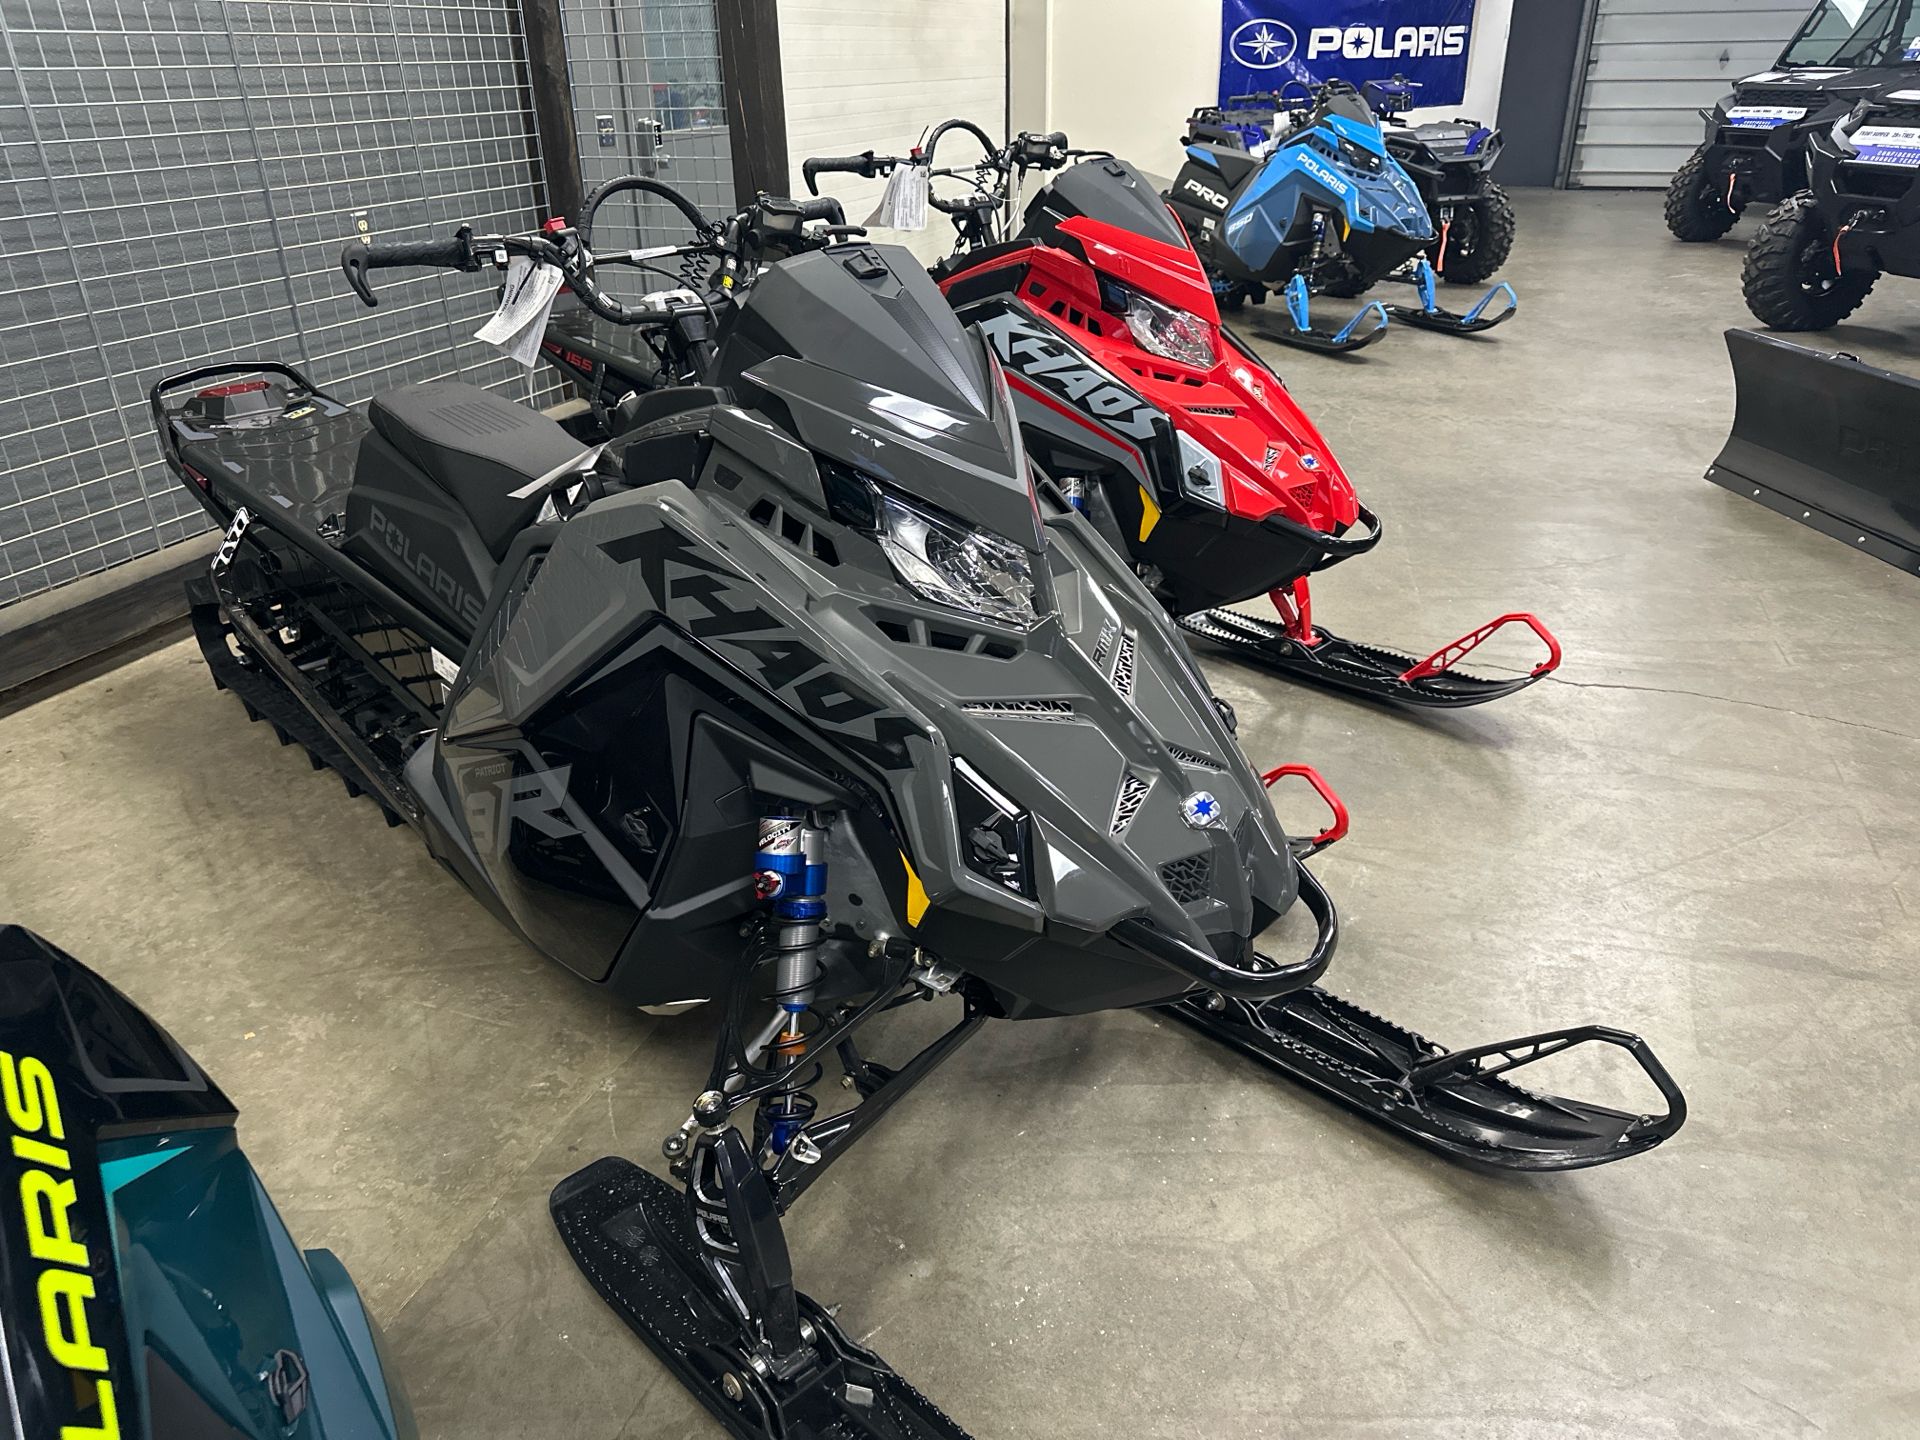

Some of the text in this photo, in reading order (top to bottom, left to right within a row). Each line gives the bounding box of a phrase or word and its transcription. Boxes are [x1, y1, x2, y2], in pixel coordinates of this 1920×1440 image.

[1307, 26, 1466, 60] POLARIS
[1297, 152, 1349, 195] POLARIS
[1183, 179, 1230, 210] PRO
[980, 309, 1170, 440] KHAOS
[370, 504, 484, 629] POLARIS
[595, 519, 938, 771] KHAOS
[474, 762, 507, 778] PATRIOT
[758, 824, 791, 847] VELOCITY
